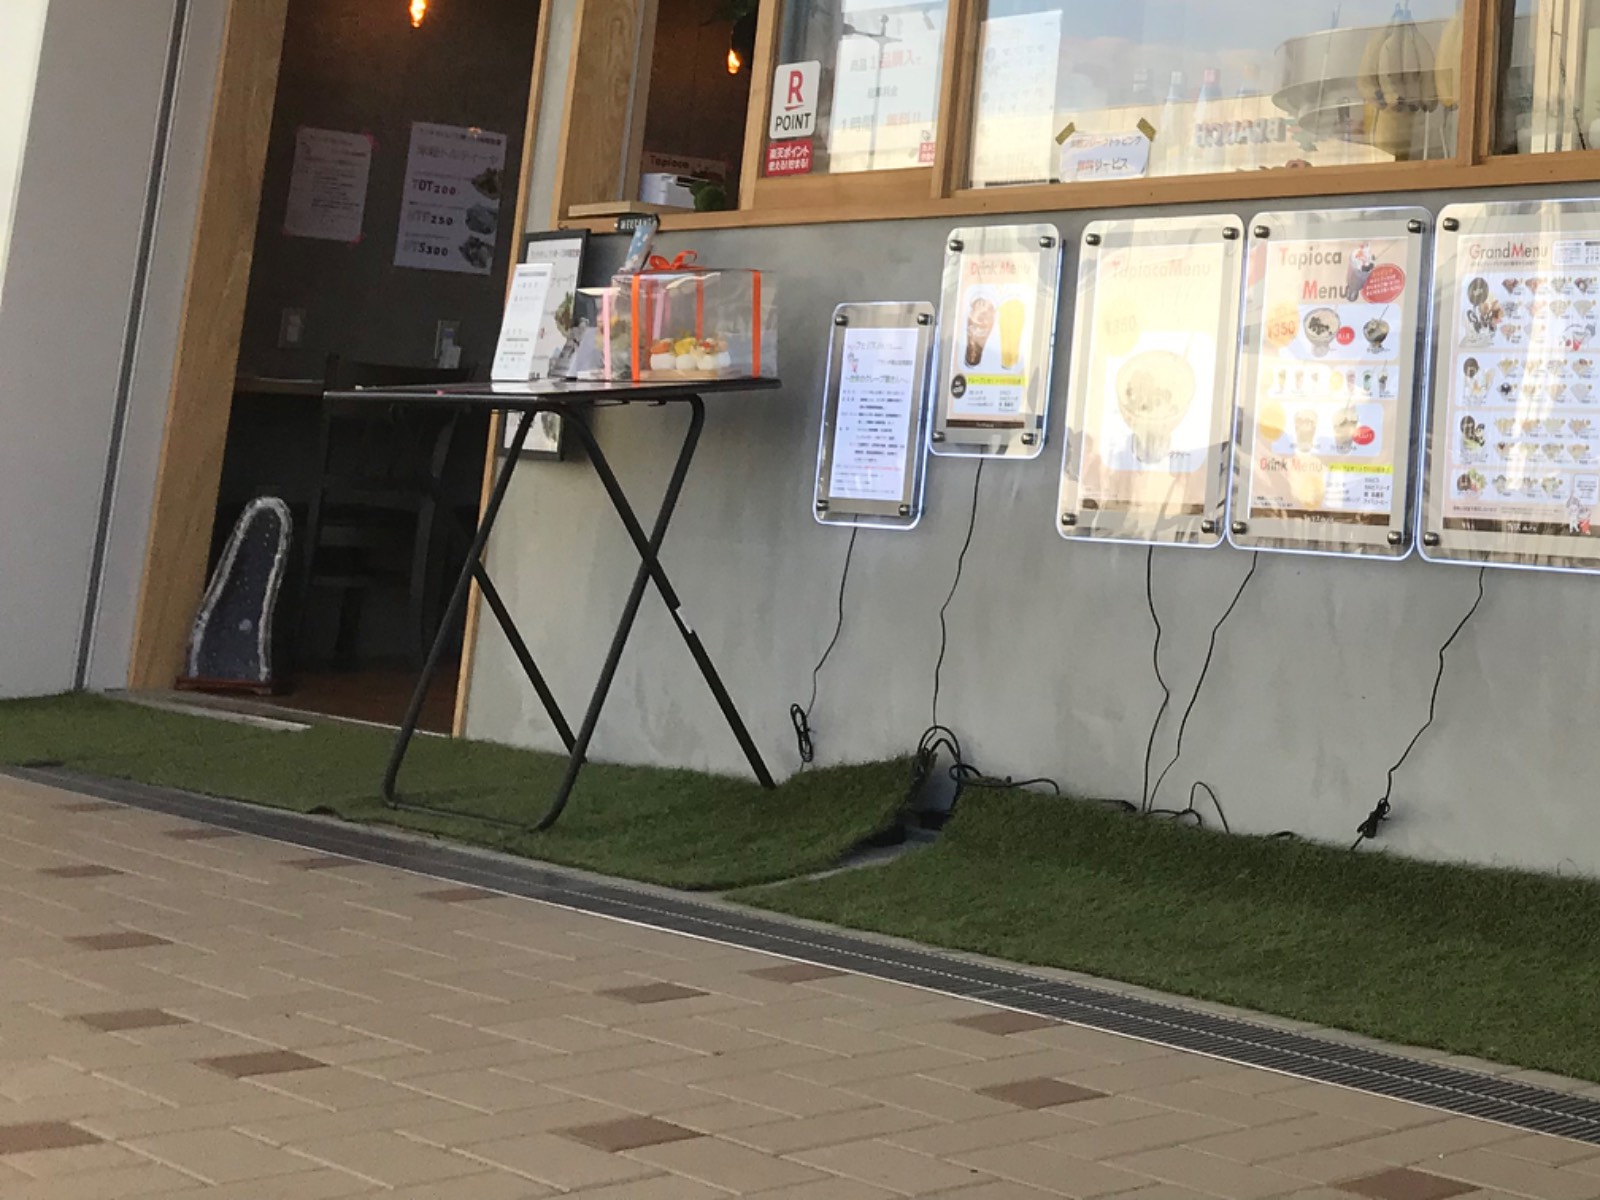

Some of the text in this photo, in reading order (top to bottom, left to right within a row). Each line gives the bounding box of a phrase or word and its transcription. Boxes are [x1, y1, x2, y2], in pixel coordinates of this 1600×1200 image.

[787, 70, 804, 104] R
[774, 112, 812, 133] POINT
[1280, 246, 1343, 270] Tapioca
[1302, 280, 1349, 300] Menu
[1260, 457, 1289, 472] Drink
